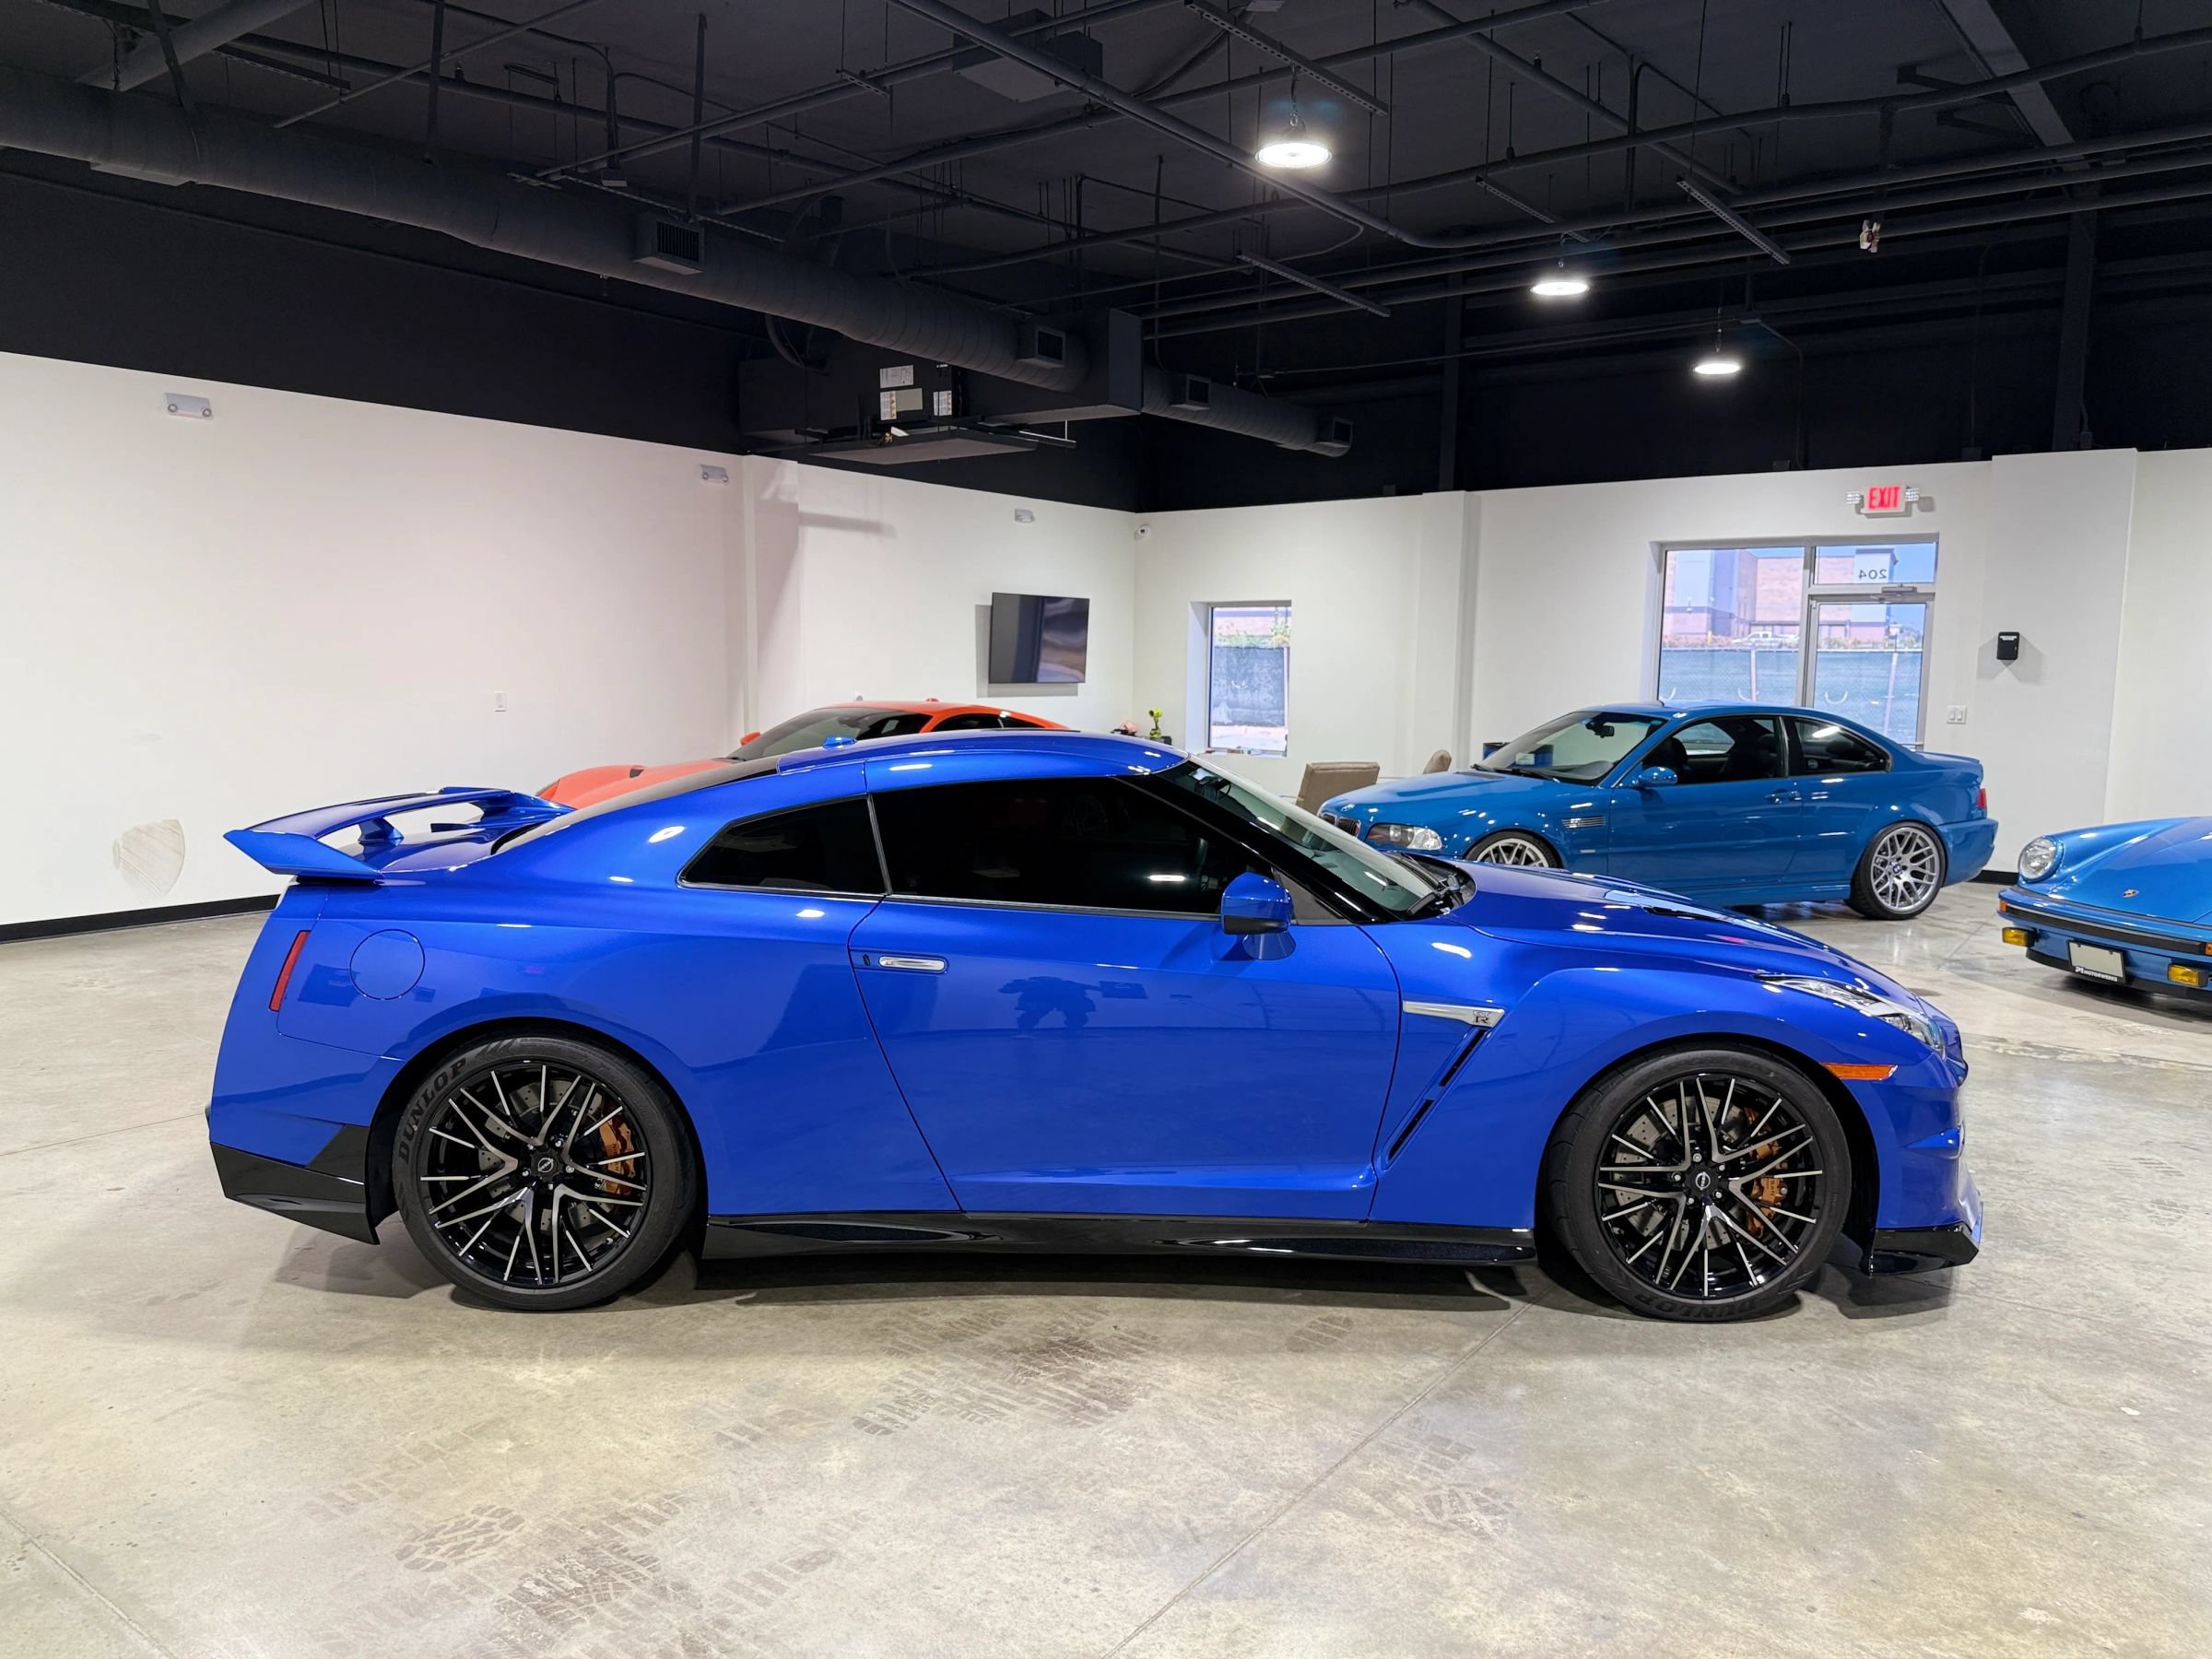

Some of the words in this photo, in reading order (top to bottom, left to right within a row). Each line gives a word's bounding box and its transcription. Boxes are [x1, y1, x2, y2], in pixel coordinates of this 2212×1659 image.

[1868, 486, 1900, 510] EXIT
[398, 1057, 466, 1165] DUNLOP
[1634, 1293, 1756, 1318] DUNLOP
